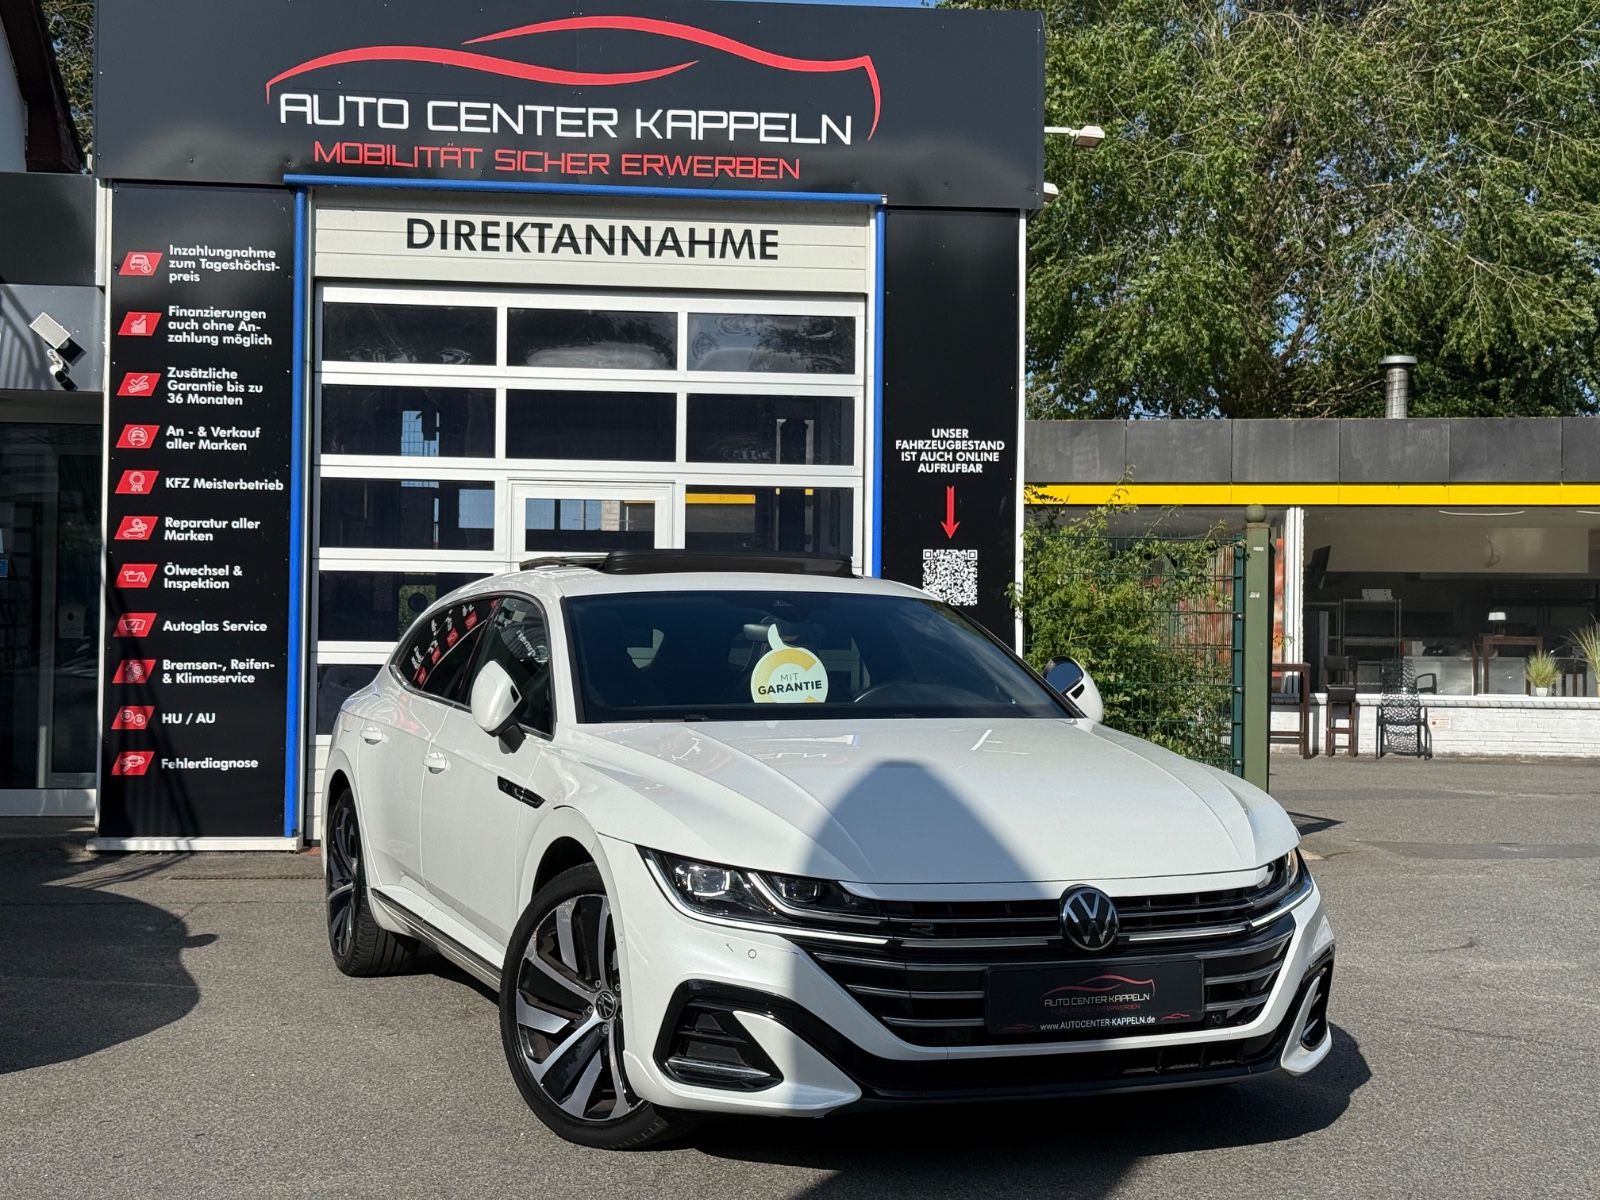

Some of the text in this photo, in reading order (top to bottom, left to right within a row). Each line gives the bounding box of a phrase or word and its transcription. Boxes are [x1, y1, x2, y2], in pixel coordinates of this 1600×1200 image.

[280, 94, 851, 145] AUTO CENTER KAPPELN
[314, 141, 800, 179] MOBILITÄT SICHER ERWERBEN
[407, 217, 781, 260] DIREKTANNAHME
[170, 245, 275, 259] Inzahlungnahme
[169, 258, 280, 272] zum Tageshöchst-
[169, 271, 200, 283] preis
[169, 306, 266, 320] Finanzierungen
[168, 320, 261, 331] auch ohne An-
[168, 332, 272, 347] zahlung möglich
[168, 367, 237, 379] Zusätzliche
[167, 380, 263, 393] Garantie bis zu
[167, 393, 242, 405] 36 Monaten
[166, 426, 184, 436] An
[198, 426, 207, 437] &
[211, 427, 260, 438] Verkauf
[932, 429, 968, 438] UNSER
[166, 439, 246, 450] aller Marken
[896, 440, 1005, 450] FAHRZEUGBESTAND
[901, 452, 999, 461] IST AUCH ONLINE
[918, 463, 982, 473] AUFRUFBAR
[166, 478, 283, 490] KFZ Meisterbetrieb
[165, 517, 260, 531] Reparatur aller
[164, 530, 213, 541] Marken
[164, 562, 242, 576] Ölwechsel &
[164, 578, 229, 591] Inspektion
[163, 620, 267, 634] Autoglas Service
[163, 659, 275, 671] Bremsen-, Reifen-
[163, 672, 255, 683] & Klimaservice
[780, 673, 799, 681] MIT
[758, 680, 823, 695] GARANTIE
[163, 713, 182, 724] HU
[196, 713, 215, 723] AU
[162, 758, 258, 771] Fehlerdiagnose
[1071, 996, 1107, 1005] CENTER
[1109, 993, 1150, 1002] KAPPELN
[1040, 1016, 1155, 1031] www.AUTOCENTER-KAPPELN.de
